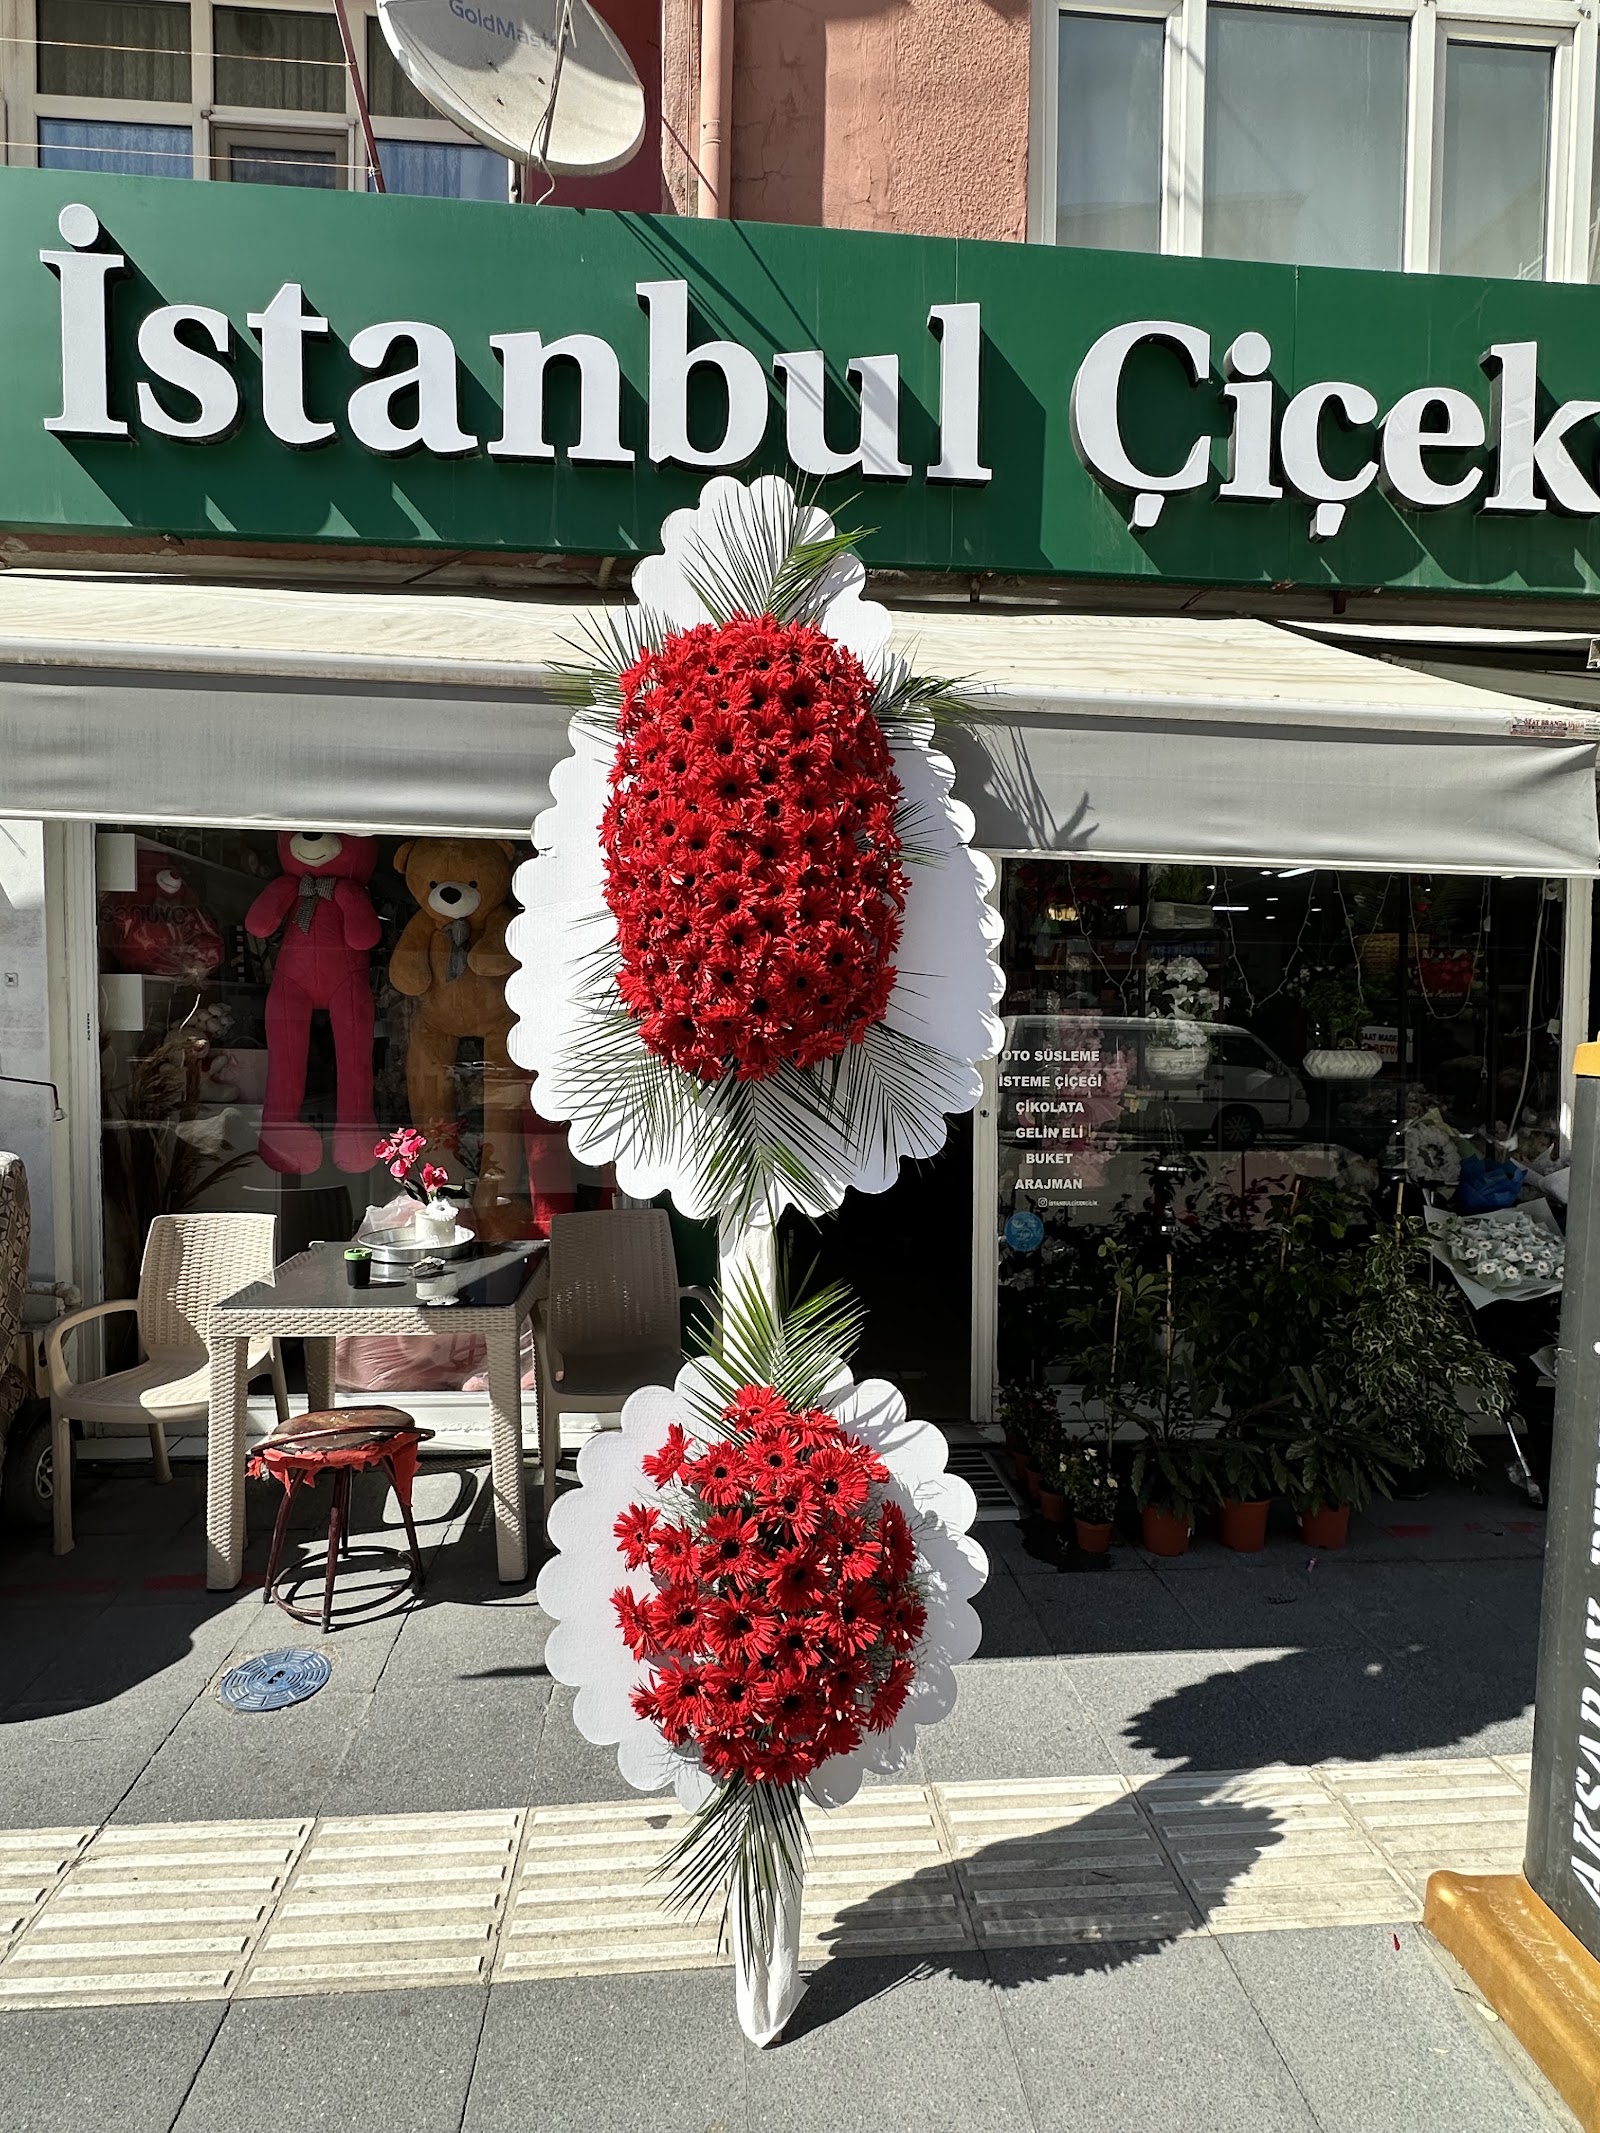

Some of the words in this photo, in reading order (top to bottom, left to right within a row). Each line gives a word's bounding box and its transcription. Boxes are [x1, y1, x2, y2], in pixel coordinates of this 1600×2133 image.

[449, 0, 560, 51] GoldMaste
[39, 203, 992, 482] İstanbul
[1072, 319, 1600, 537] Çiçek
[1002, 1050, 1031, 1061] OTO
[1034, 1048, 1100, 1062] SÜSLEME
[999, 1074, 1051, 1087] İSTEME
[1055, 1074, 1102, 1090] ÇİÇEĞİ
[1015, 1099, 1085, 1116] ÇİKOLATA
[1062, 1125, 1084, 1139] ELİ
[1026, 1153, 1074, 1164] BUKET
[1014, 1179, 1083, 1190] ARAJMAN
